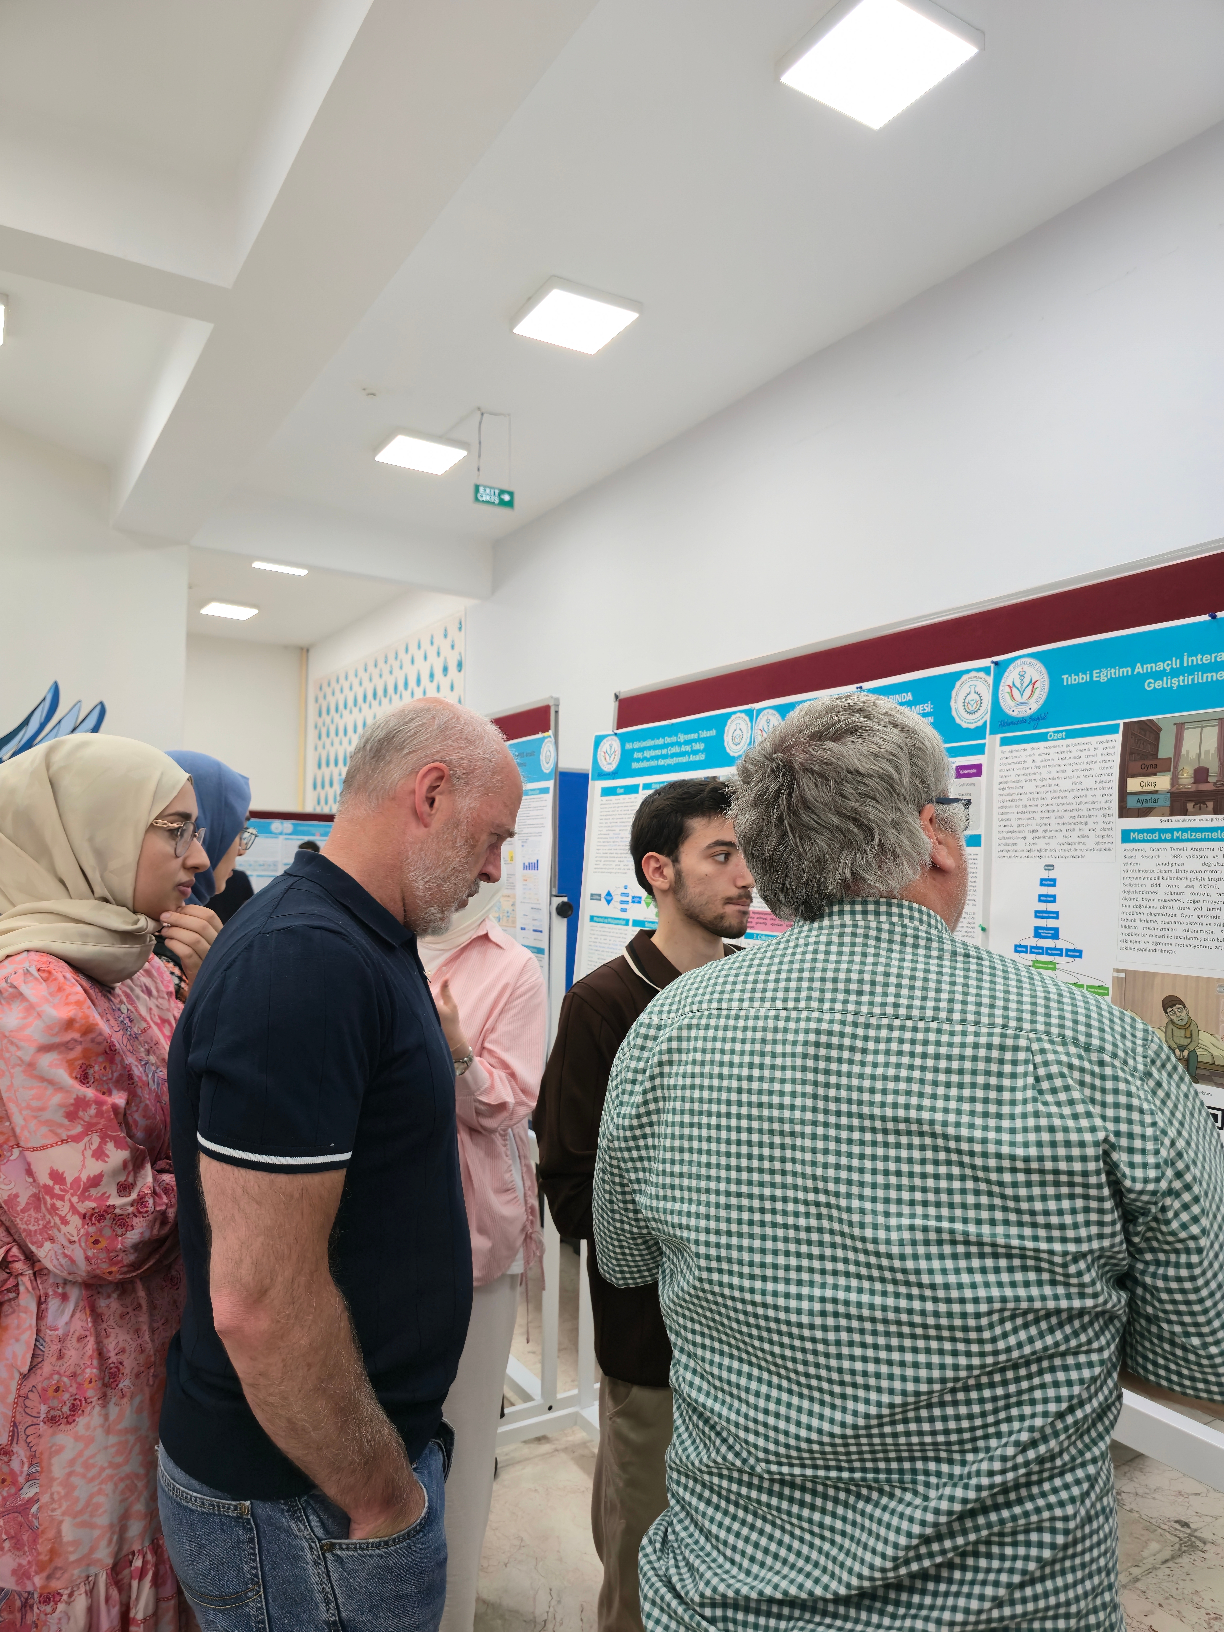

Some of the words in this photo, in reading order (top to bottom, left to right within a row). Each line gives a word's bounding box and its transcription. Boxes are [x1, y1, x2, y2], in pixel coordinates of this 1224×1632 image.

[1061, 671, 1090, 686] Tıbbi
[1092, 666, 1132, 682] Eğitim
[1133, 657, 1180, 675] Amaçlı
[1183, 652, 1224, 667] İntera
[1144, 671, 1224, 691] Geliştirilme
[1047, 731, 1066, 740] Özet
[1140, 763, 1158, 771] Oyna
[1139, 780, 1157, 789] Çıkış
[1136, 797, 1160, 806] Ayarlar
[1130, 831, 1159, 840] Metod
